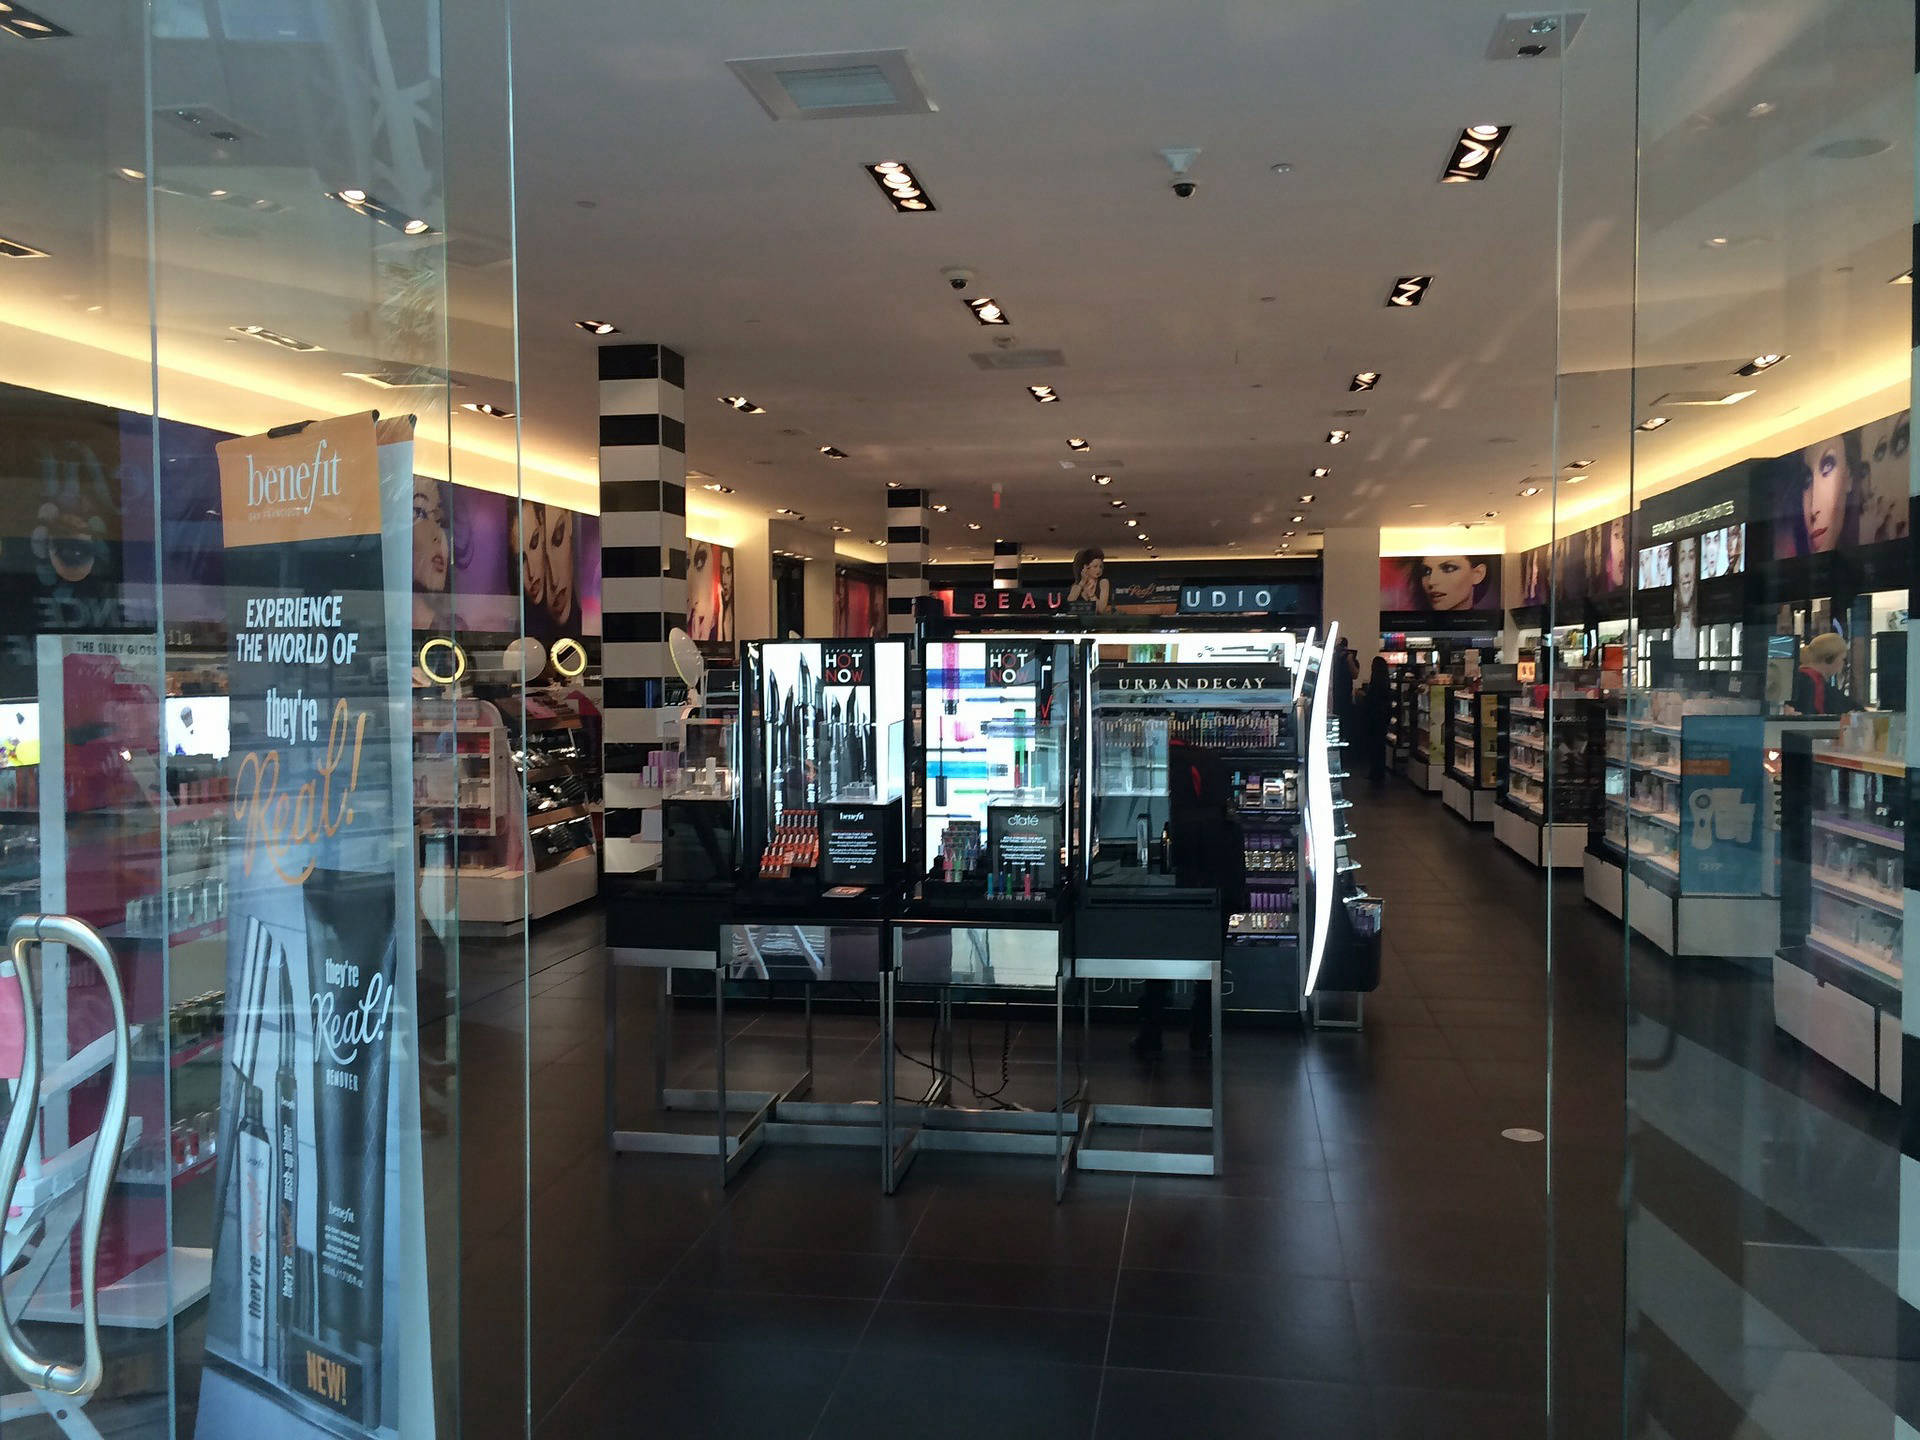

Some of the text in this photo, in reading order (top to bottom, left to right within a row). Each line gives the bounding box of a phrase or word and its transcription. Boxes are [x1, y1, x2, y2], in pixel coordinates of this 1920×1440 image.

[246, 439, 342, 514] benefit
[246, 596, 343, 628] EXPERIENCE
[973, 592, 1061, 610] BEAU
[1186, 590, 1272, 607] UDIO
[77, 641, 95, 653] THE
[98, 643, 124, 654] SILKY
[236, 632, 359, 665] THE WORLD OF
[825, 653, 863, 668] HOT
[990, 653, 1029, 668] HOT
[825, 668, 864, 683] NOW
[990, 668, 1029, 683] NOW
[1118, 678, 1267, 693] URBAN DECAY
[266, 687, 318, 745] they're
[234, 697, 367, 886] Real!
[325, 957, 360, 988] they're
[311, 971, 393, 1065] Real!
[306, 1350, 347, 1405] NEW!
